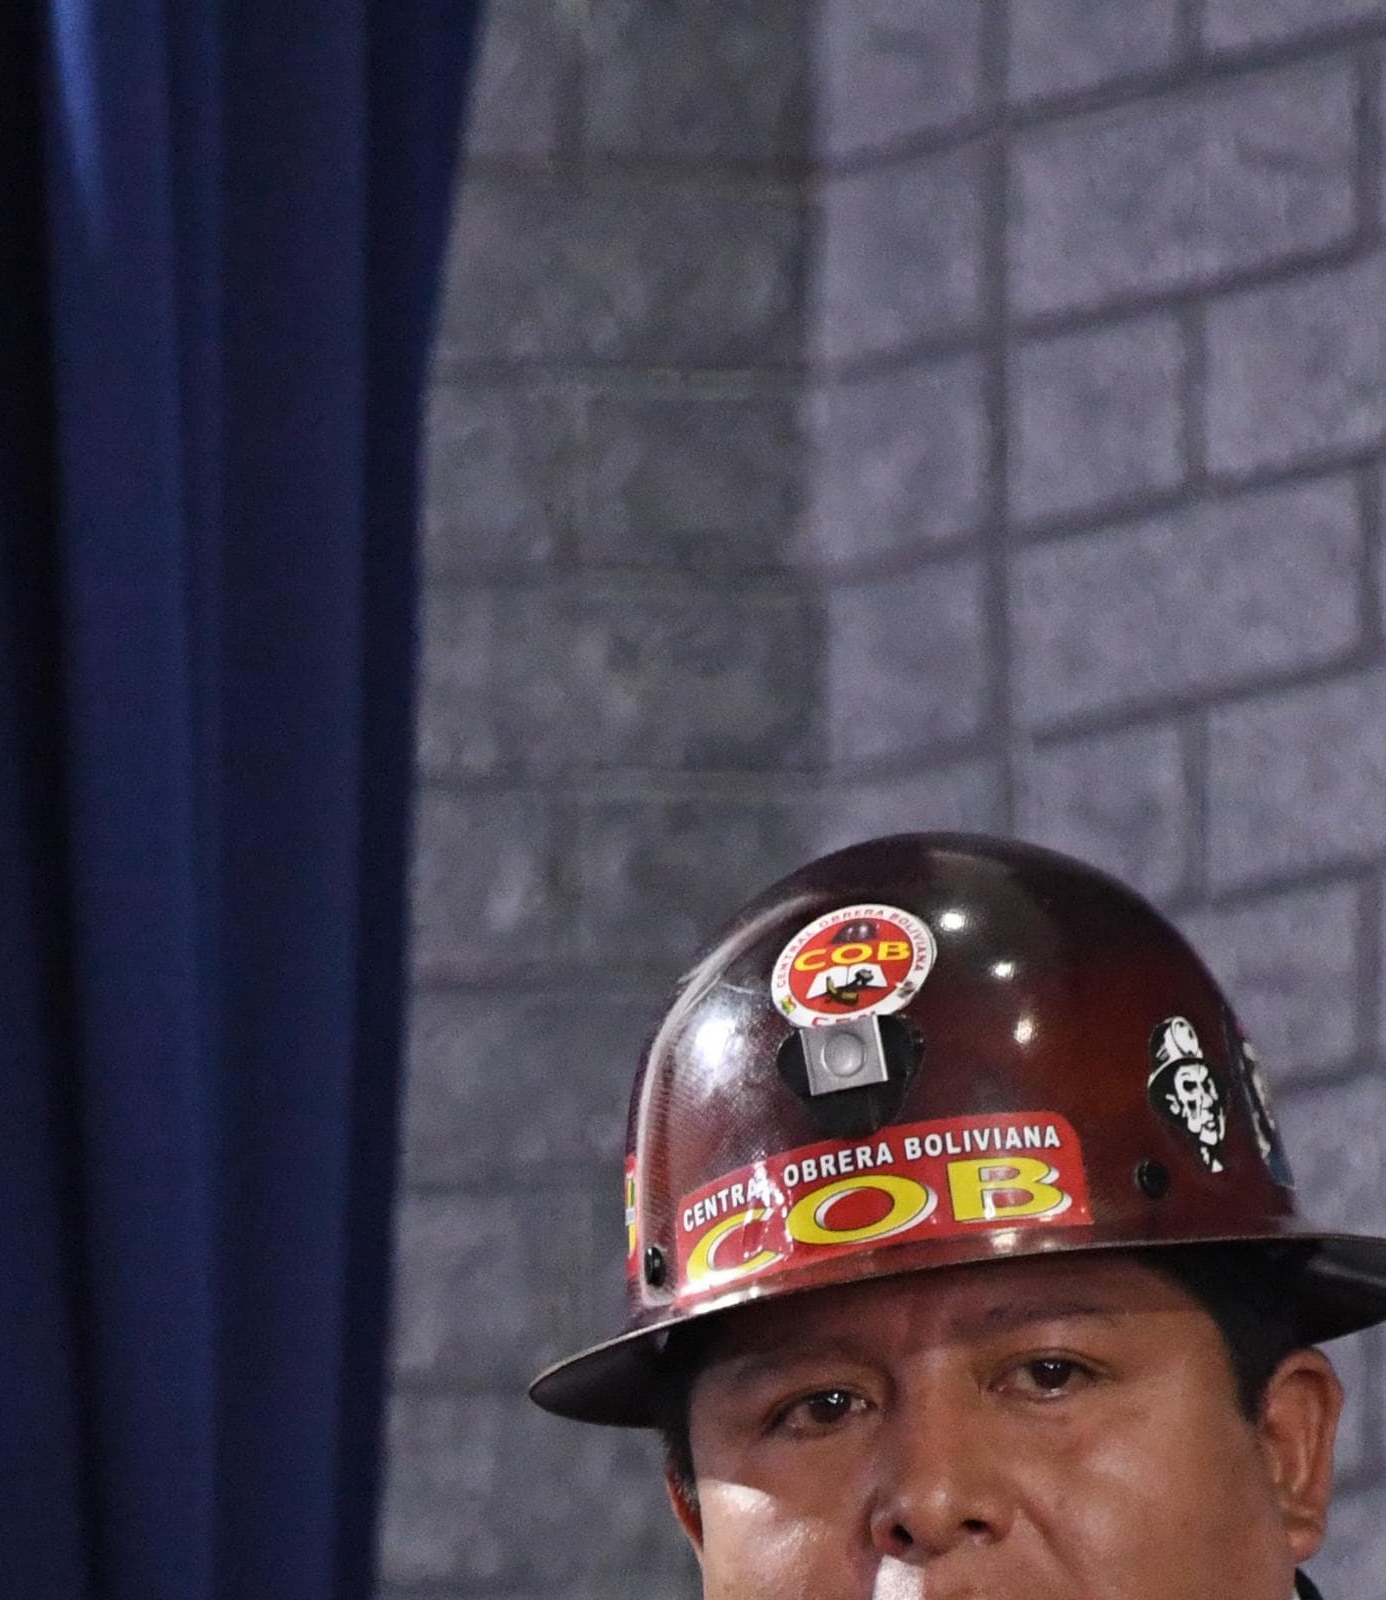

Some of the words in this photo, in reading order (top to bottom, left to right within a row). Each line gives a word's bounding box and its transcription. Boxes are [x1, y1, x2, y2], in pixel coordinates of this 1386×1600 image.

[777, 929, 814, 988] CENTRAL
[819, 908, 884, 928] OBRERA
[889, 912, 927, 971] BOLIVIANA
[794, 940, 911, 972] COB
[783, 1142, 894, 1188] OBRERA
[904, 1125, 1060, 1161] BOLIVIANA
[686, 1156, 1073, 1285] COB
